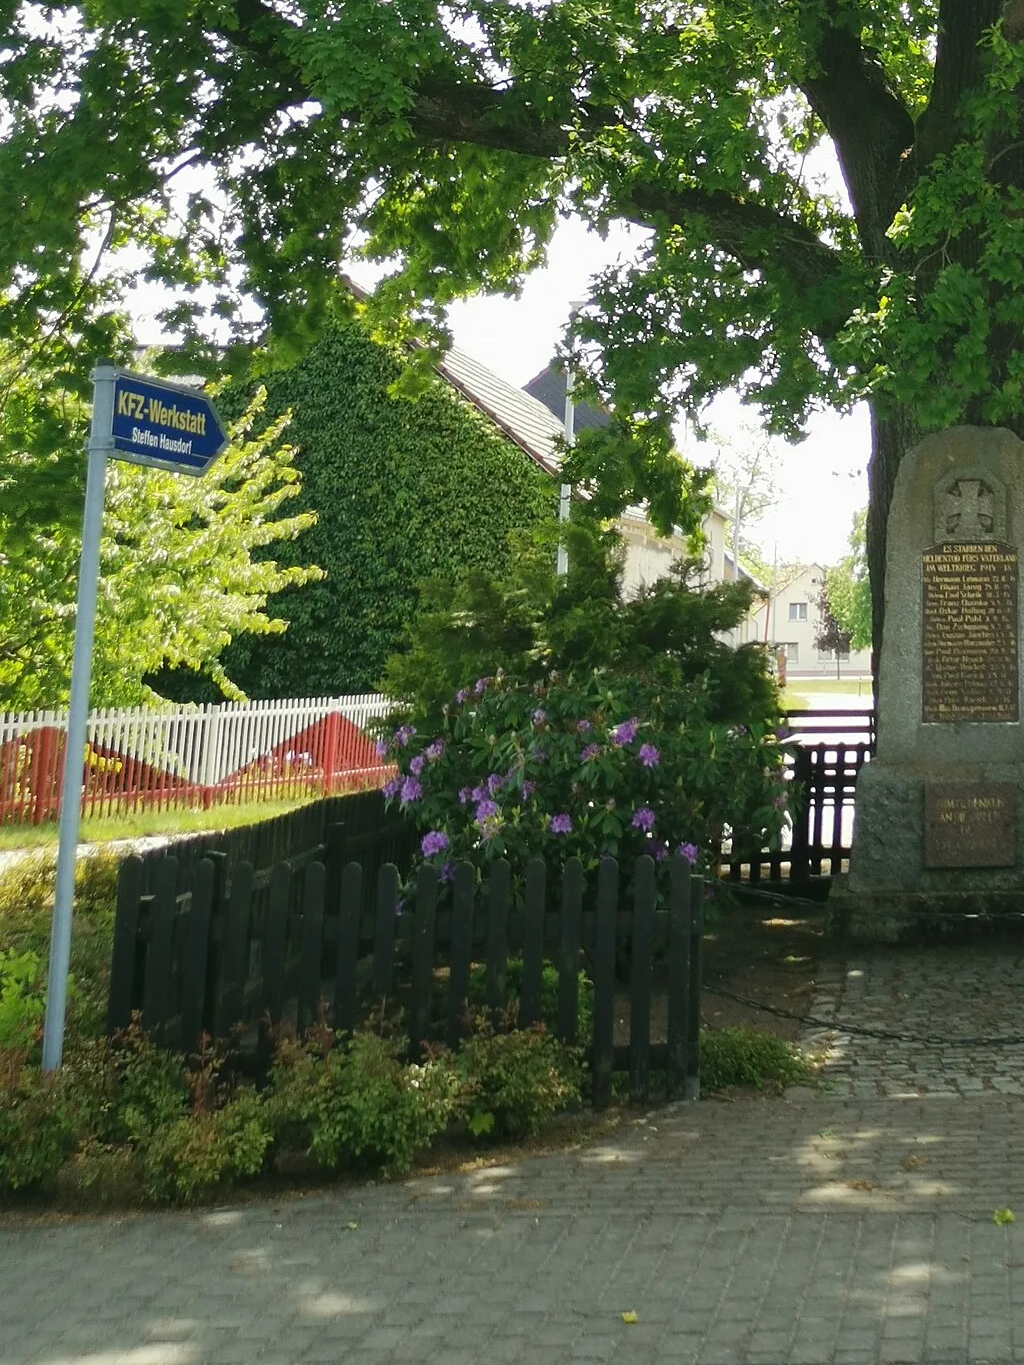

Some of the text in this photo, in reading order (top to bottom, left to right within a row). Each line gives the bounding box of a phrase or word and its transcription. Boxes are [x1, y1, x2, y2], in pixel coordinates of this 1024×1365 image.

[118, 390, 206, 435] KFZ-Werkstatt
[132, 427, 193, 455] Steffen Hausdorf
